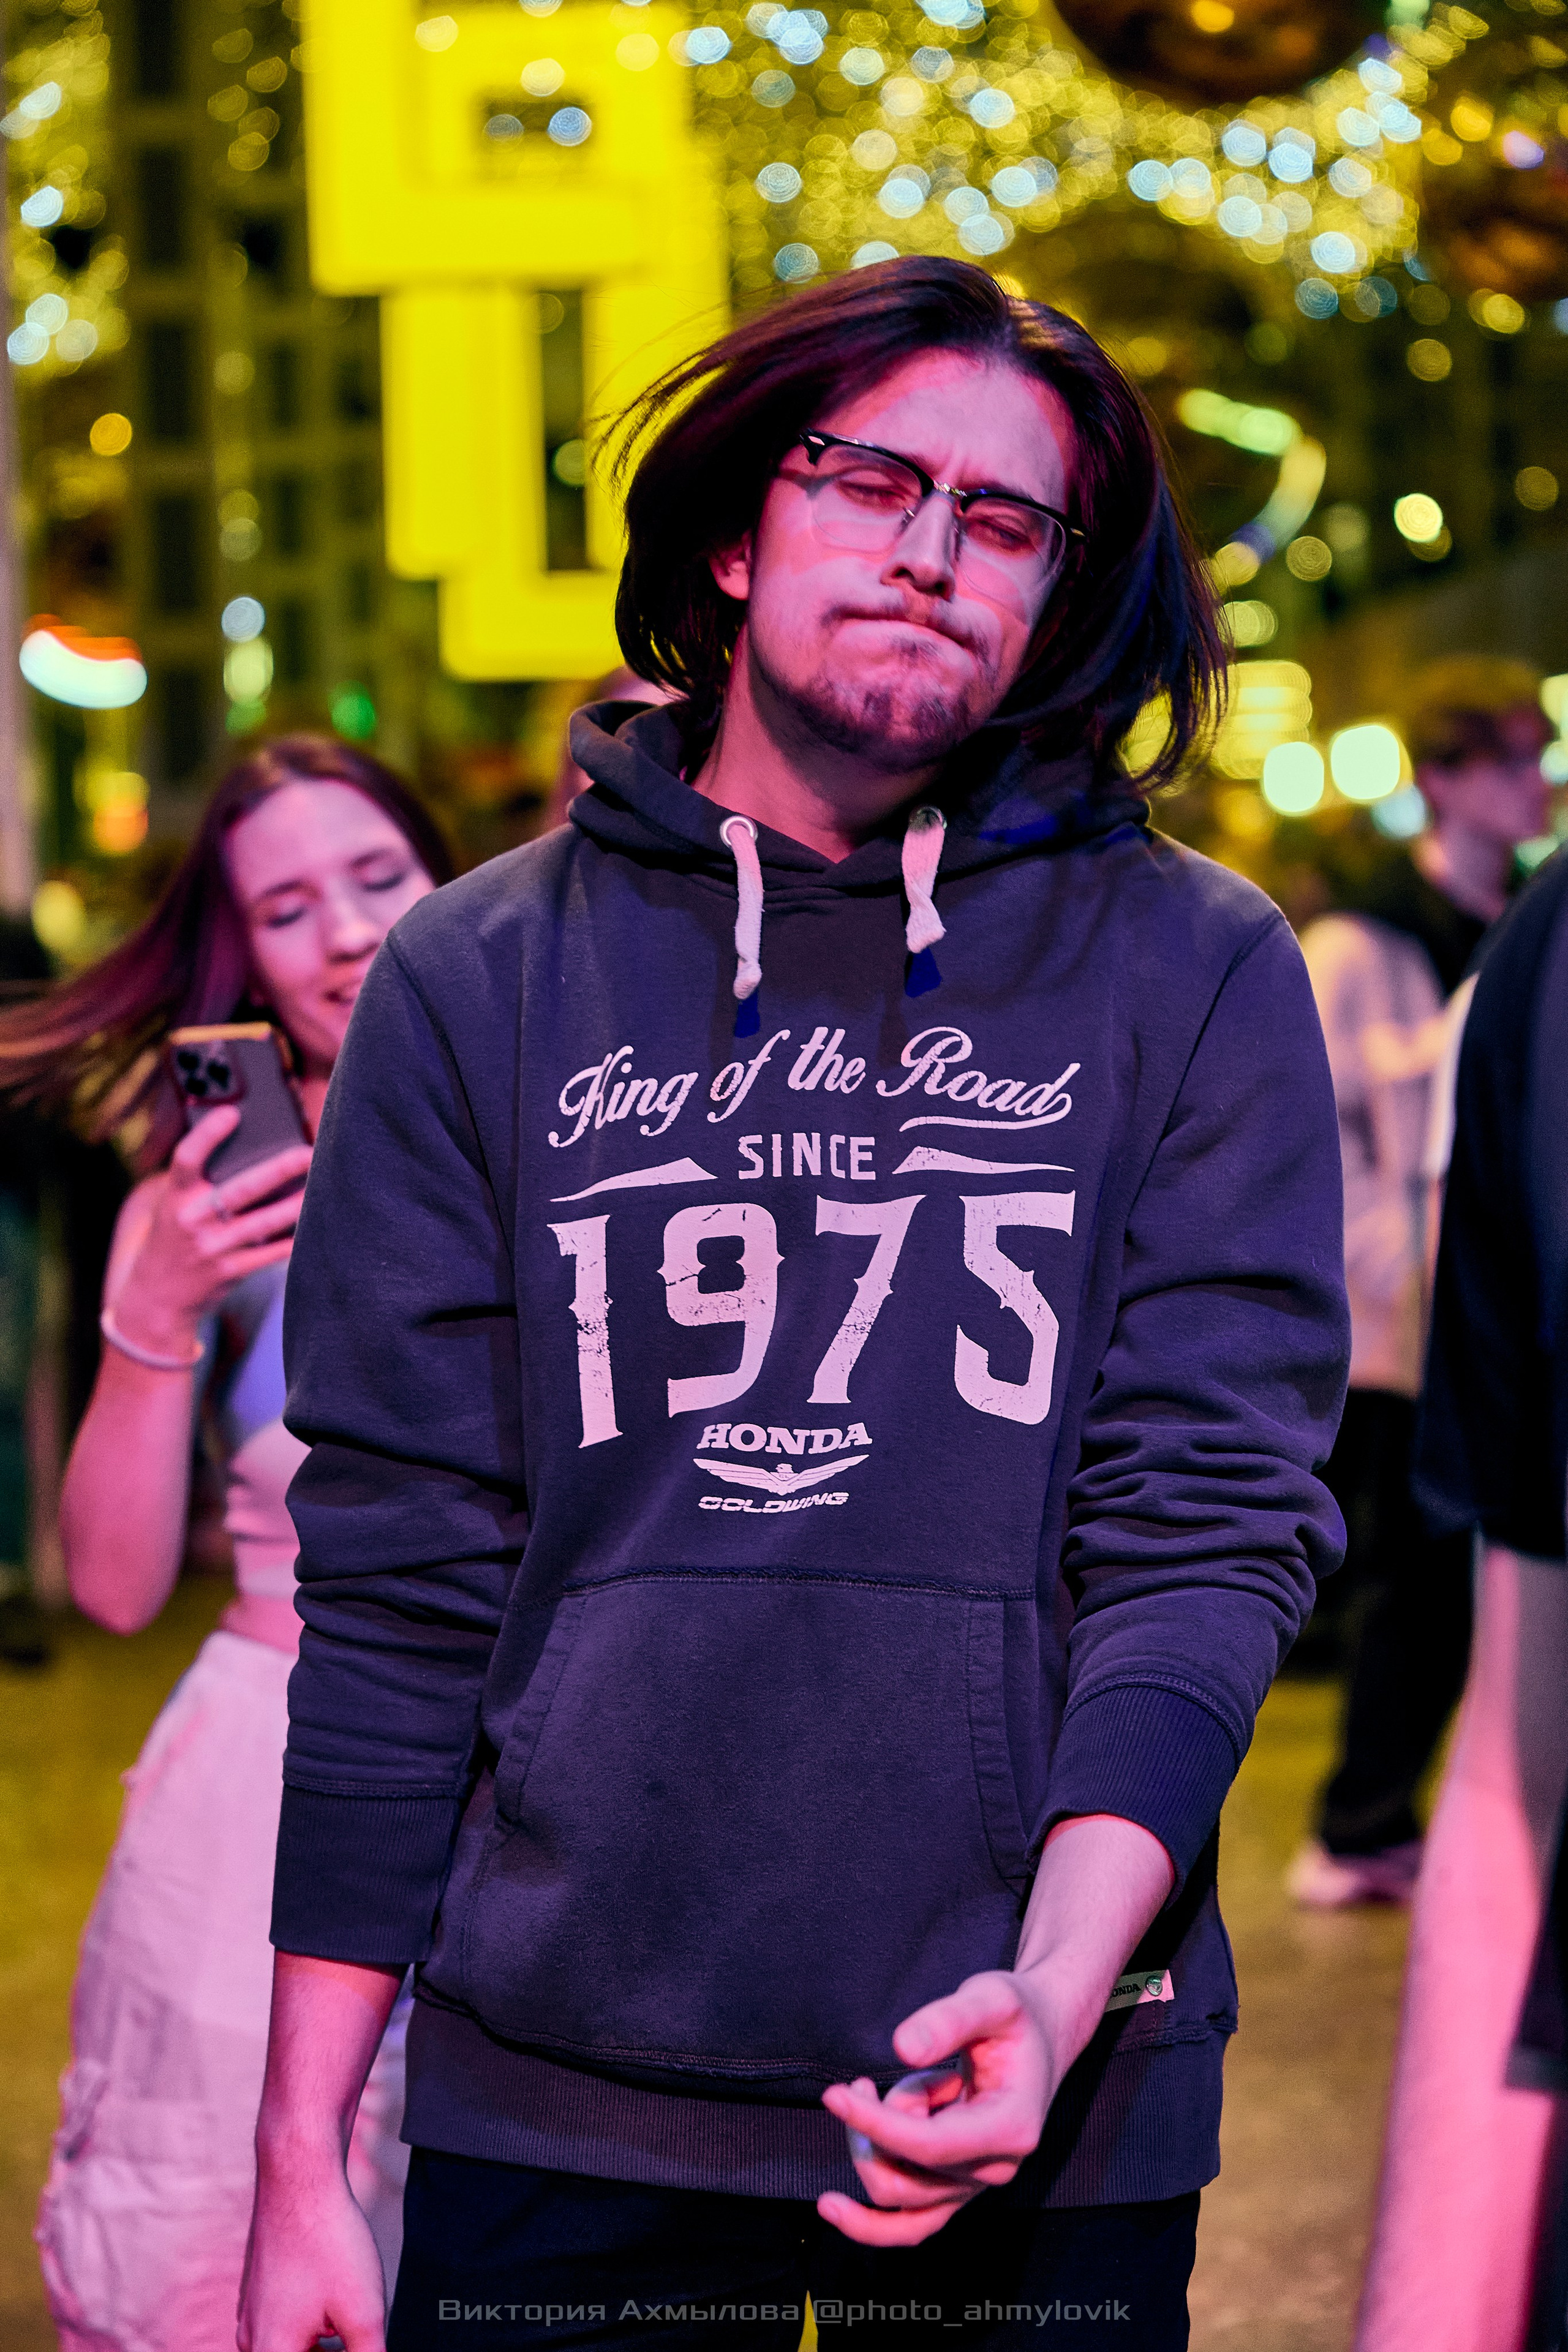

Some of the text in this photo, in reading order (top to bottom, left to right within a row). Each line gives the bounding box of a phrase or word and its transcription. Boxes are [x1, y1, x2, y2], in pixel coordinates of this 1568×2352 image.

[548, 1026, 1081, 1148] King of the Road
[737, 1131, 877, 1180] SINCE
[546, 1189, 1076, 1449] 1975
[696, 1422, 873, 1455] HONDA
[698, 1491, 850, 1513] GOLDWING
[1111, 1983, 1142, 1998] ONDA
